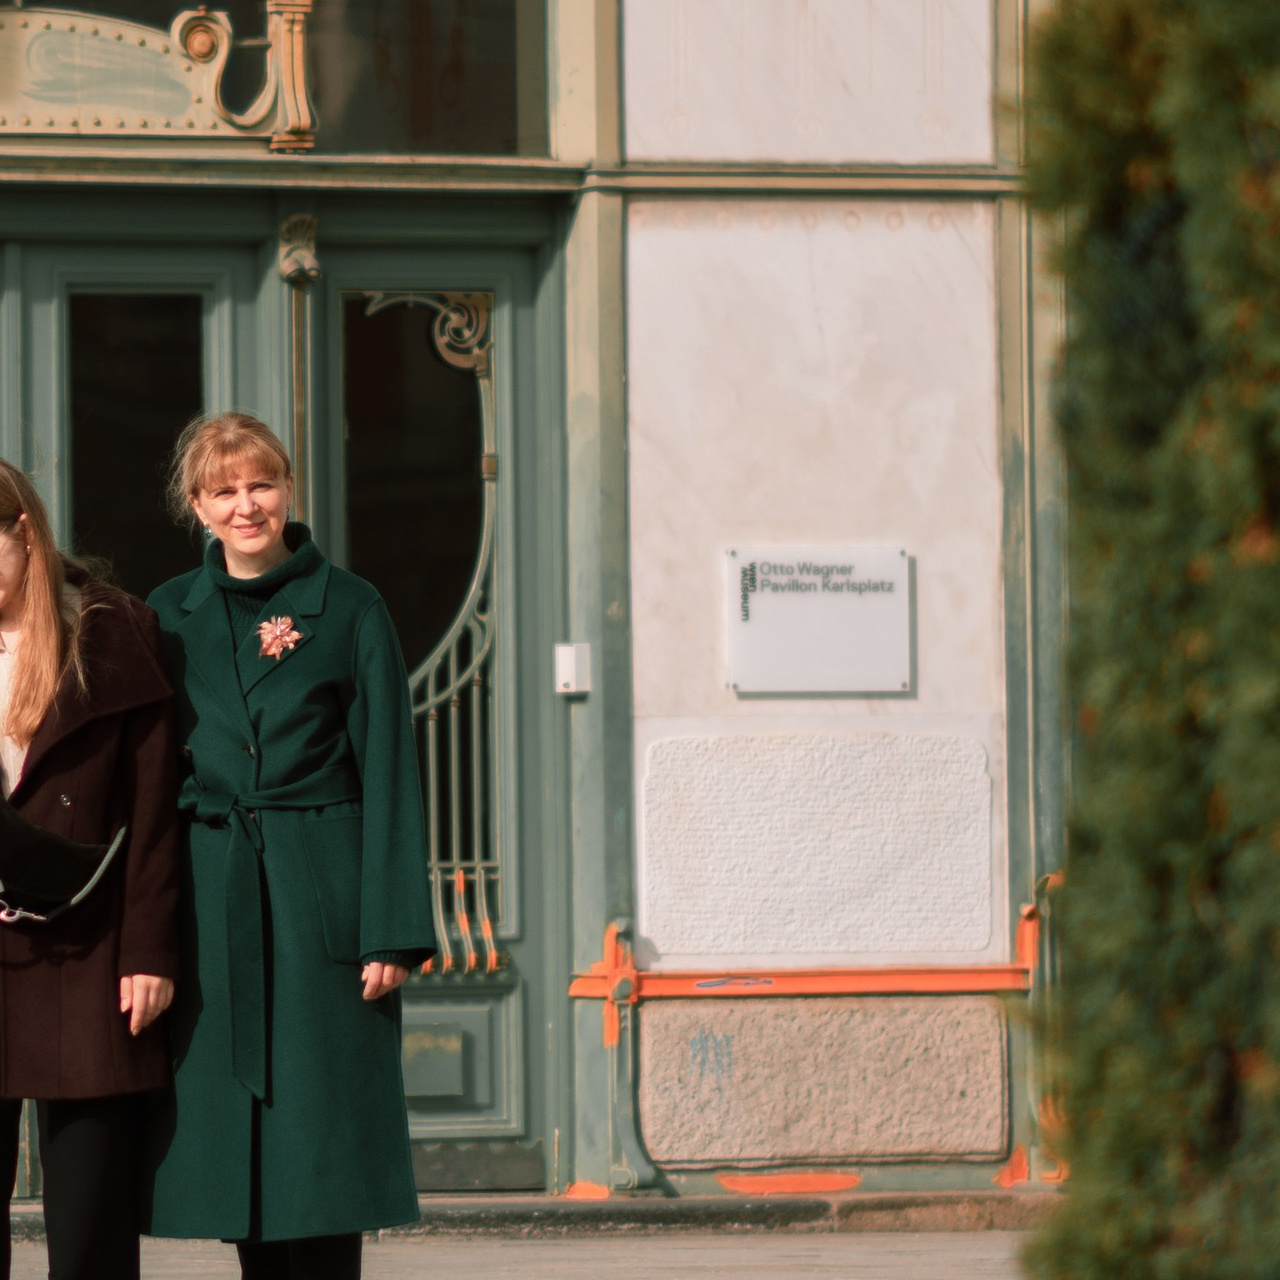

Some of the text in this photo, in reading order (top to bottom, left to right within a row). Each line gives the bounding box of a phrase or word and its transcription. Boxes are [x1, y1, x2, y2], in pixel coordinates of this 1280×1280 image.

[760, 561, 854, 579] Otto Wagner
[760, 579, 895, 596] Pavillon Karlsplatz
